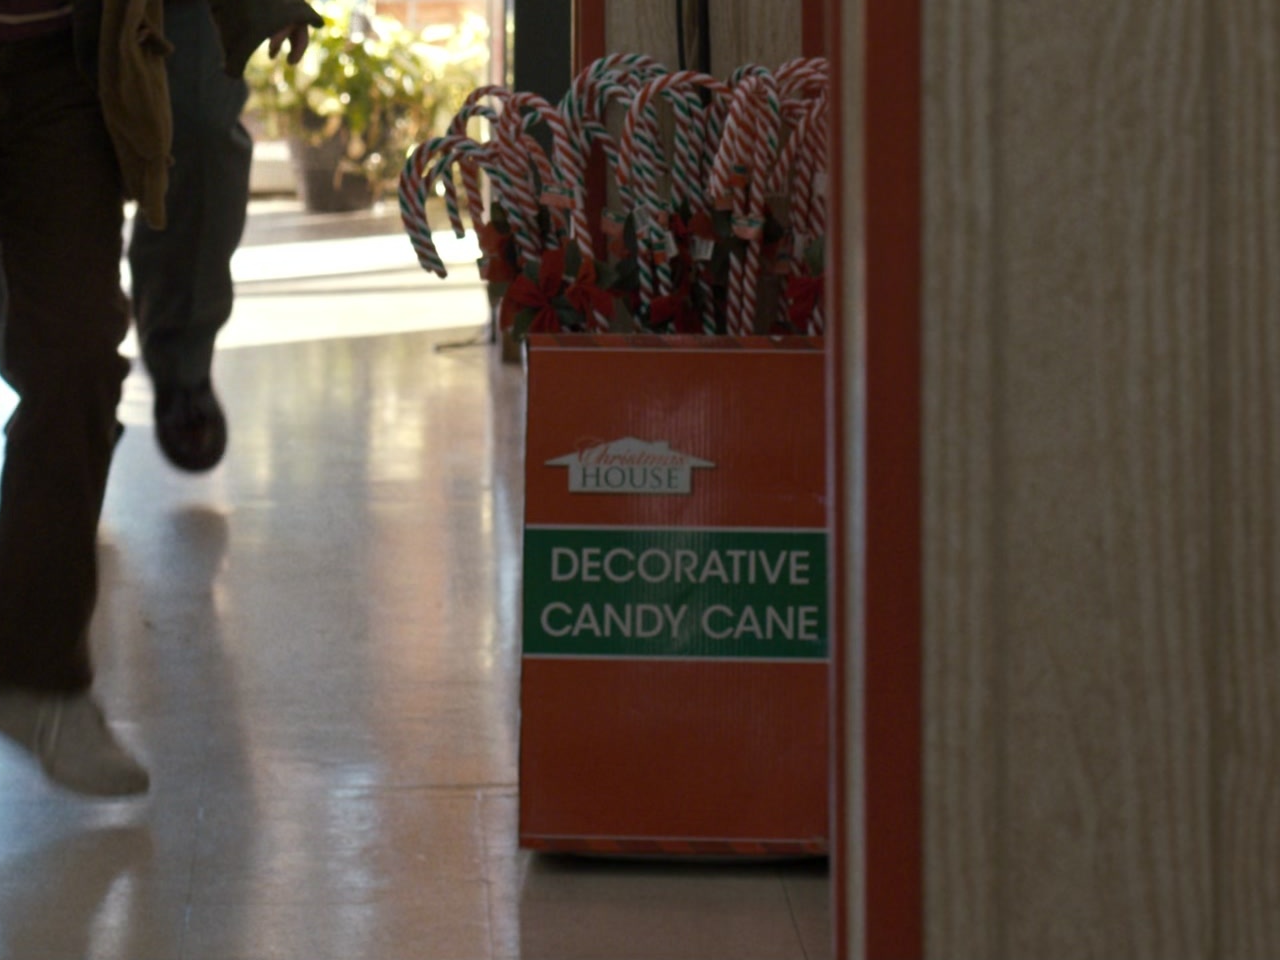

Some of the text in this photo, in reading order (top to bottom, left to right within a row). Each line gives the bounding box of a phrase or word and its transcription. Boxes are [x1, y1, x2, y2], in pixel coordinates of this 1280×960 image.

[574, 435, 687, 466] Christmas
[581, 466, 679, 489] HOUSE
[550, 547, 811, 585] DECORATIVE
[539, 602, 819, 641] CANDY CANE
